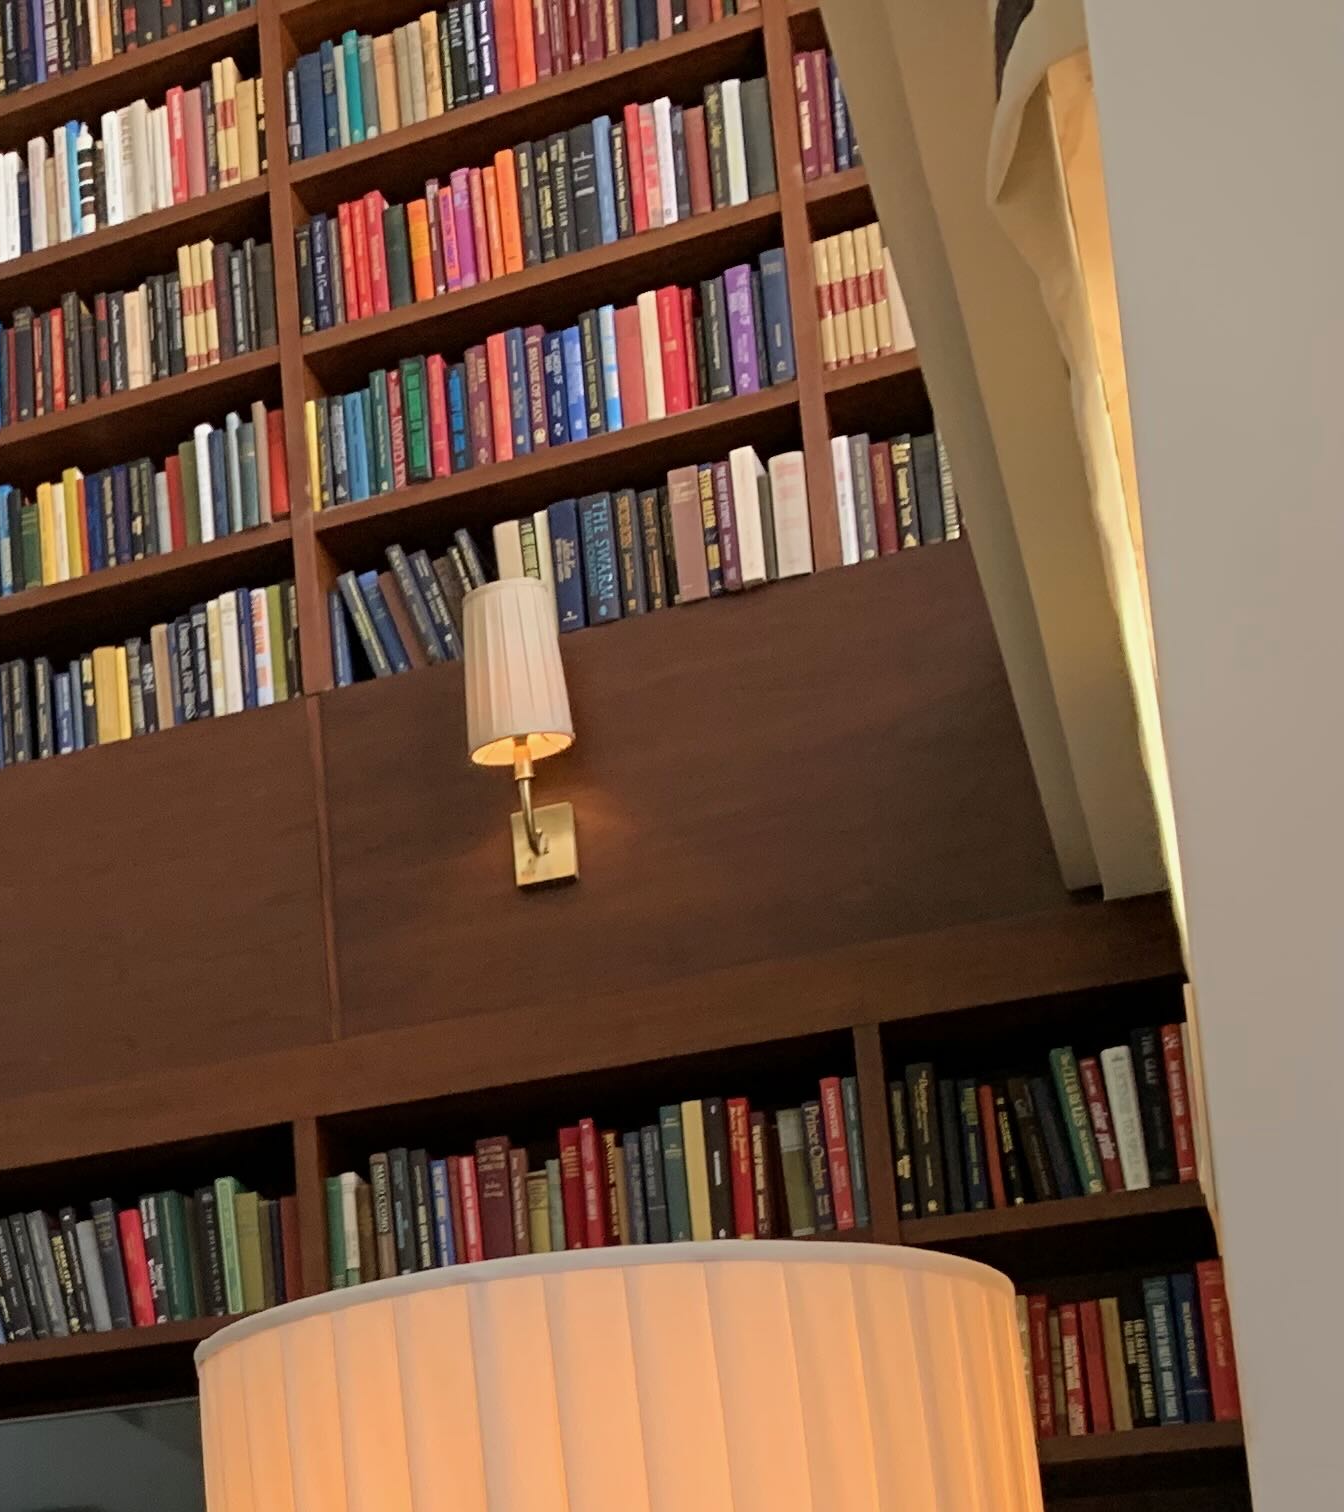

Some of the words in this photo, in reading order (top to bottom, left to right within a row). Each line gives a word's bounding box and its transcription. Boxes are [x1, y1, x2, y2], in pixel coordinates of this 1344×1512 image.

[592, 498, 609, 533] THE
[596, 539, 615, 601] SWARM
[804, 1105, 819, 1144] Prince
